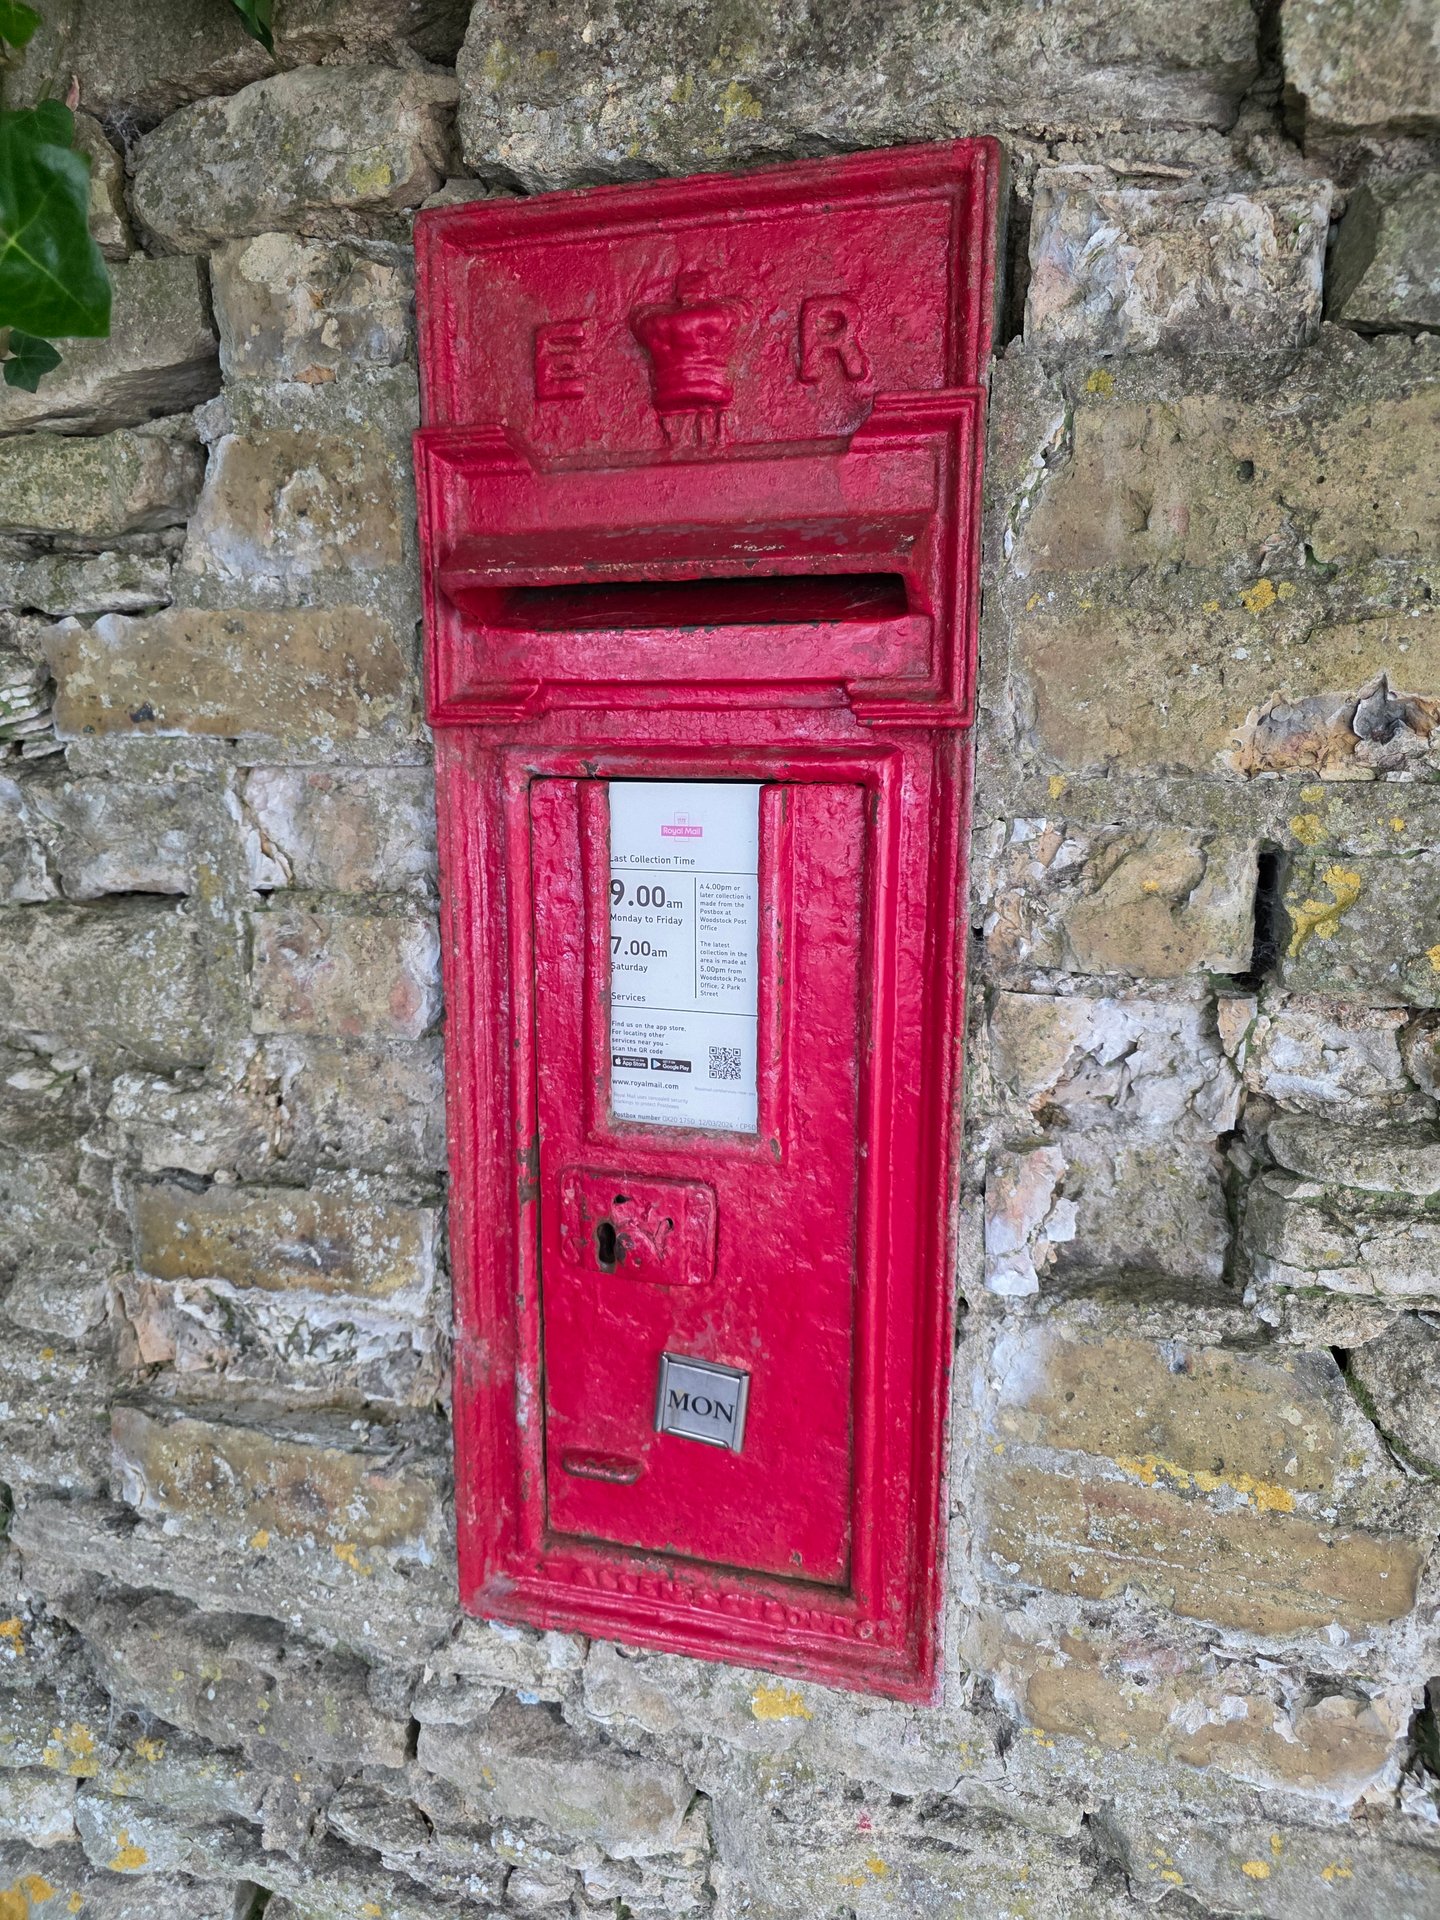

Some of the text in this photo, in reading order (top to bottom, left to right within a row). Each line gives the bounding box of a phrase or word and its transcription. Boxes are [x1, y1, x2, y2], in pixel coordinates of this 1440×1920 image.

[798, 296, 870, 385] R
[663, 827, 683, 835] Royal
[630, 855, 671, 864] Collection
[674, 856, 695, 865] Time
[611, 879, 683, 909] 9.00am
[611, 914, 683, 926] Monday to Friday
[611, 936, 667, 957] 7.00am
[611, 962, 648, 973] Saturday
[611, 992, 646, 1002] Services
[662, 1063, 679, 1071] Google
[612, 1079, 679, 1090] www.royalmail.com
[613, 1111, 636, 1119] Postbox
[638, 1113, 660, 1121] number
[667, 1389, 735, 1424] MON
